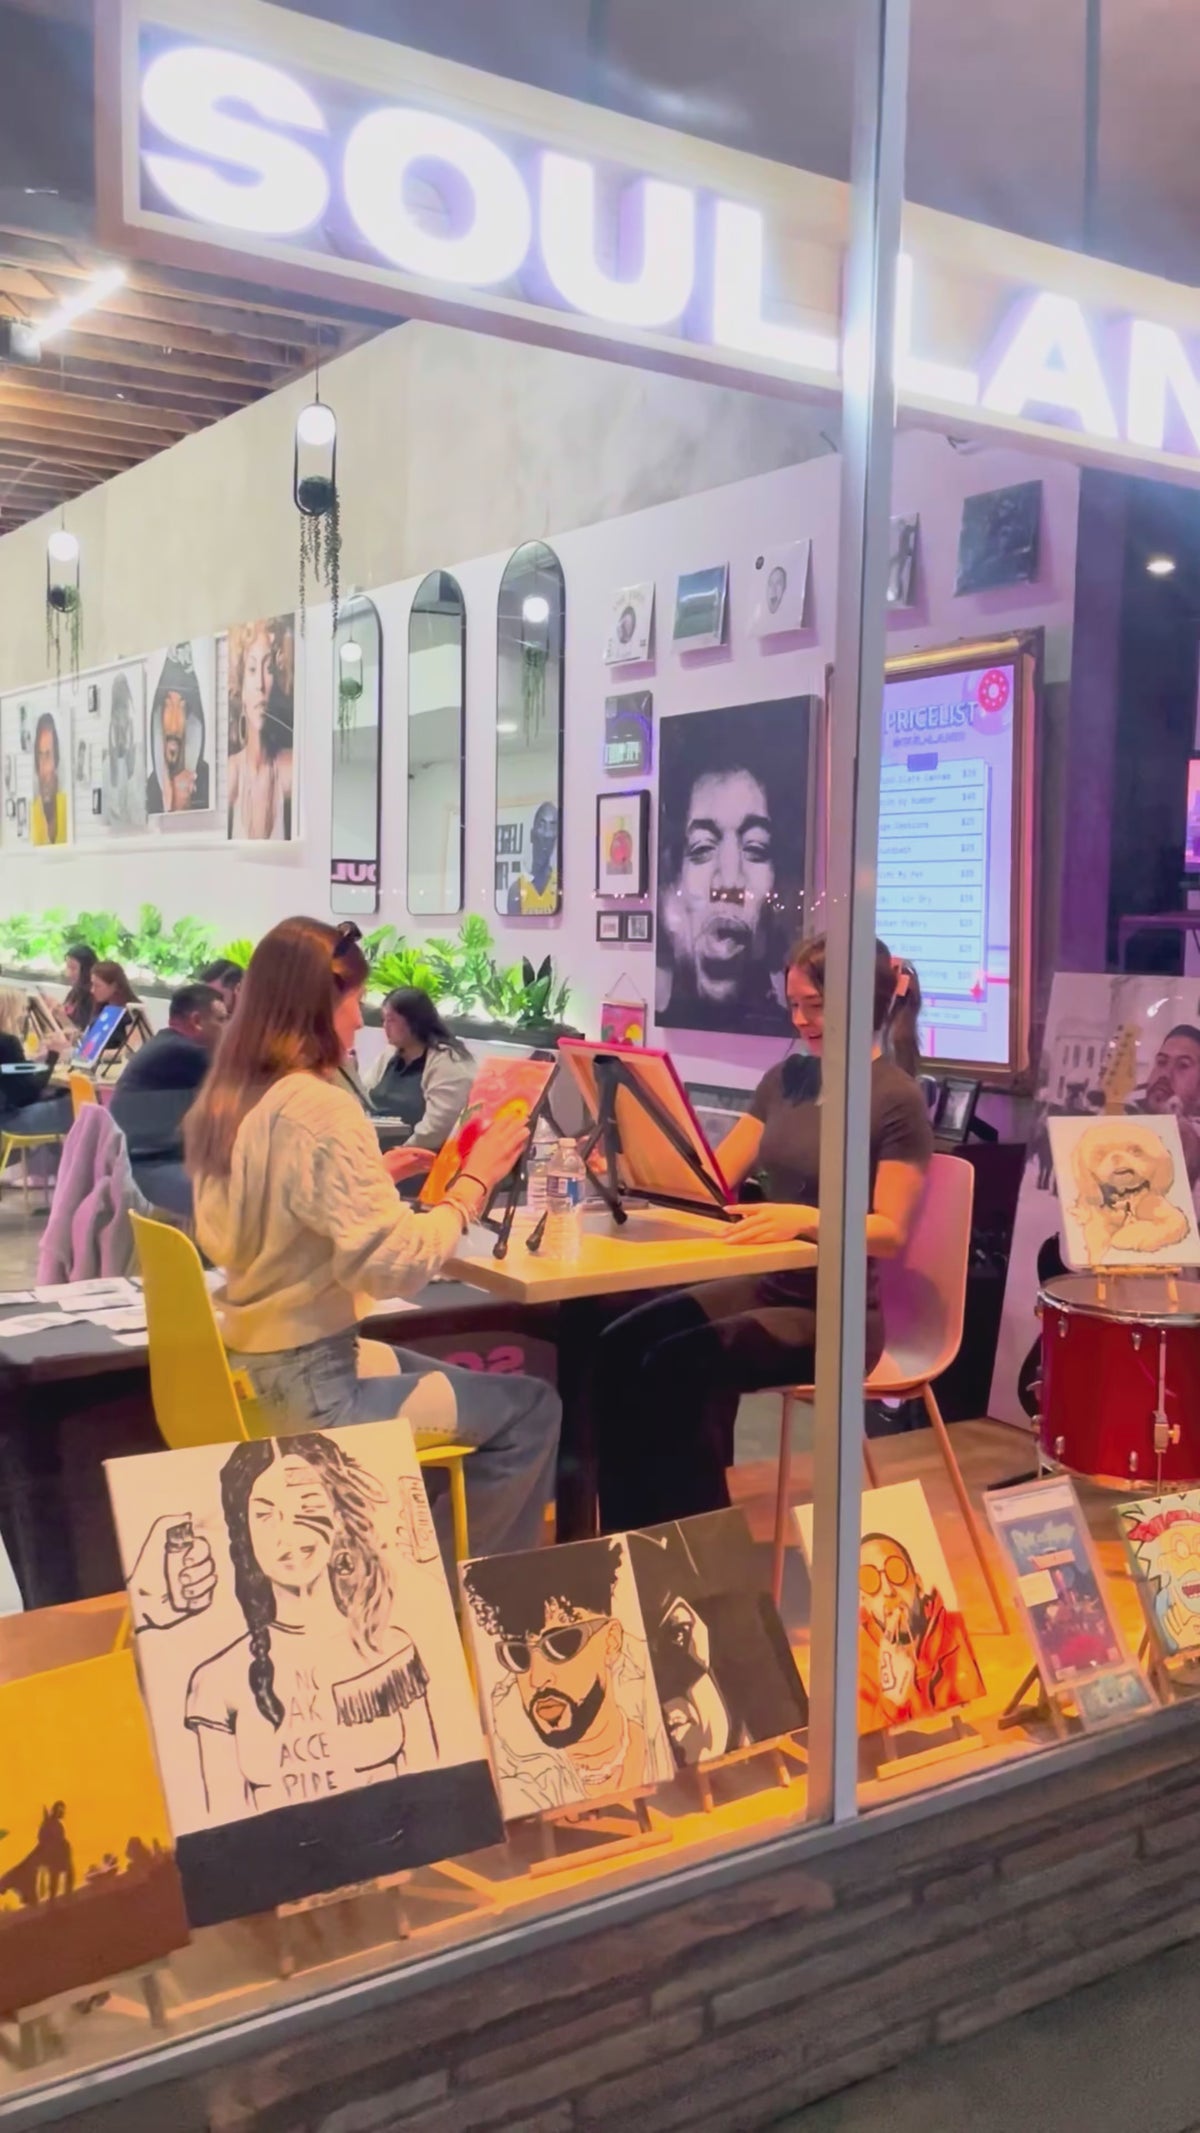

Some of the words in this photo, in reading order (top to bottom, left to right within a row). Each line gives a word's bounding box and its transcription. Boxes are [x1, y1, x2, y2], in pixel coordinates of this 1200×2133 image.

[138, 44, 839, 376] SOUL
[885, 701, 978, 734] PRICELIST
[279, 1732, 331, 1768] ACCE
